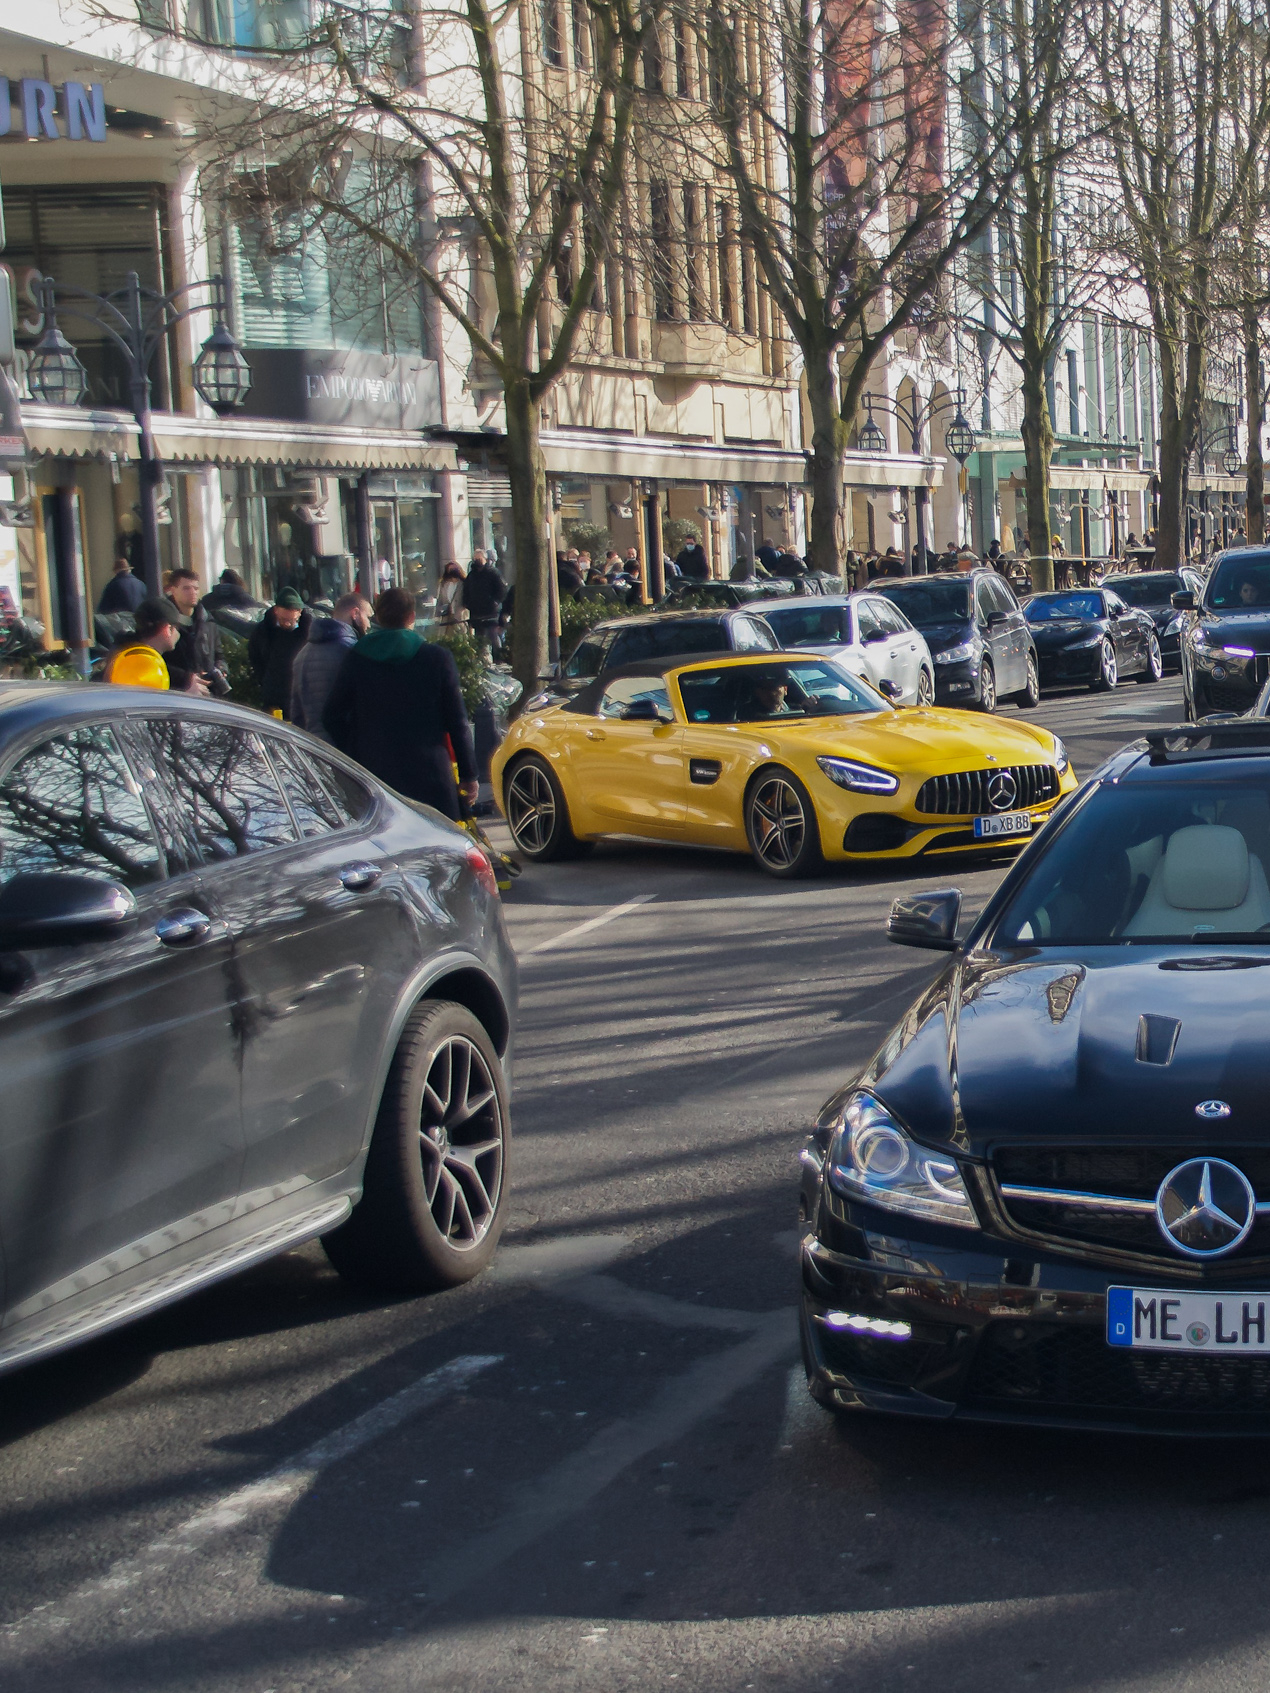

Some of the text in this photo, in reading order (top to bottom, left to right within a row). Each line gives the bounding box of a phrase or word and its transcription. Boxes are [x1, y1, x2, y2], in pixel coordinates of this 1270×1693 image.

[306, 374, 370, 401] EMPORIO
[983, 815, 1029, 834] D XB 88
[1116, 1323, 1125, 1335] D
[1135, 1297, 1182, 1341] ME
